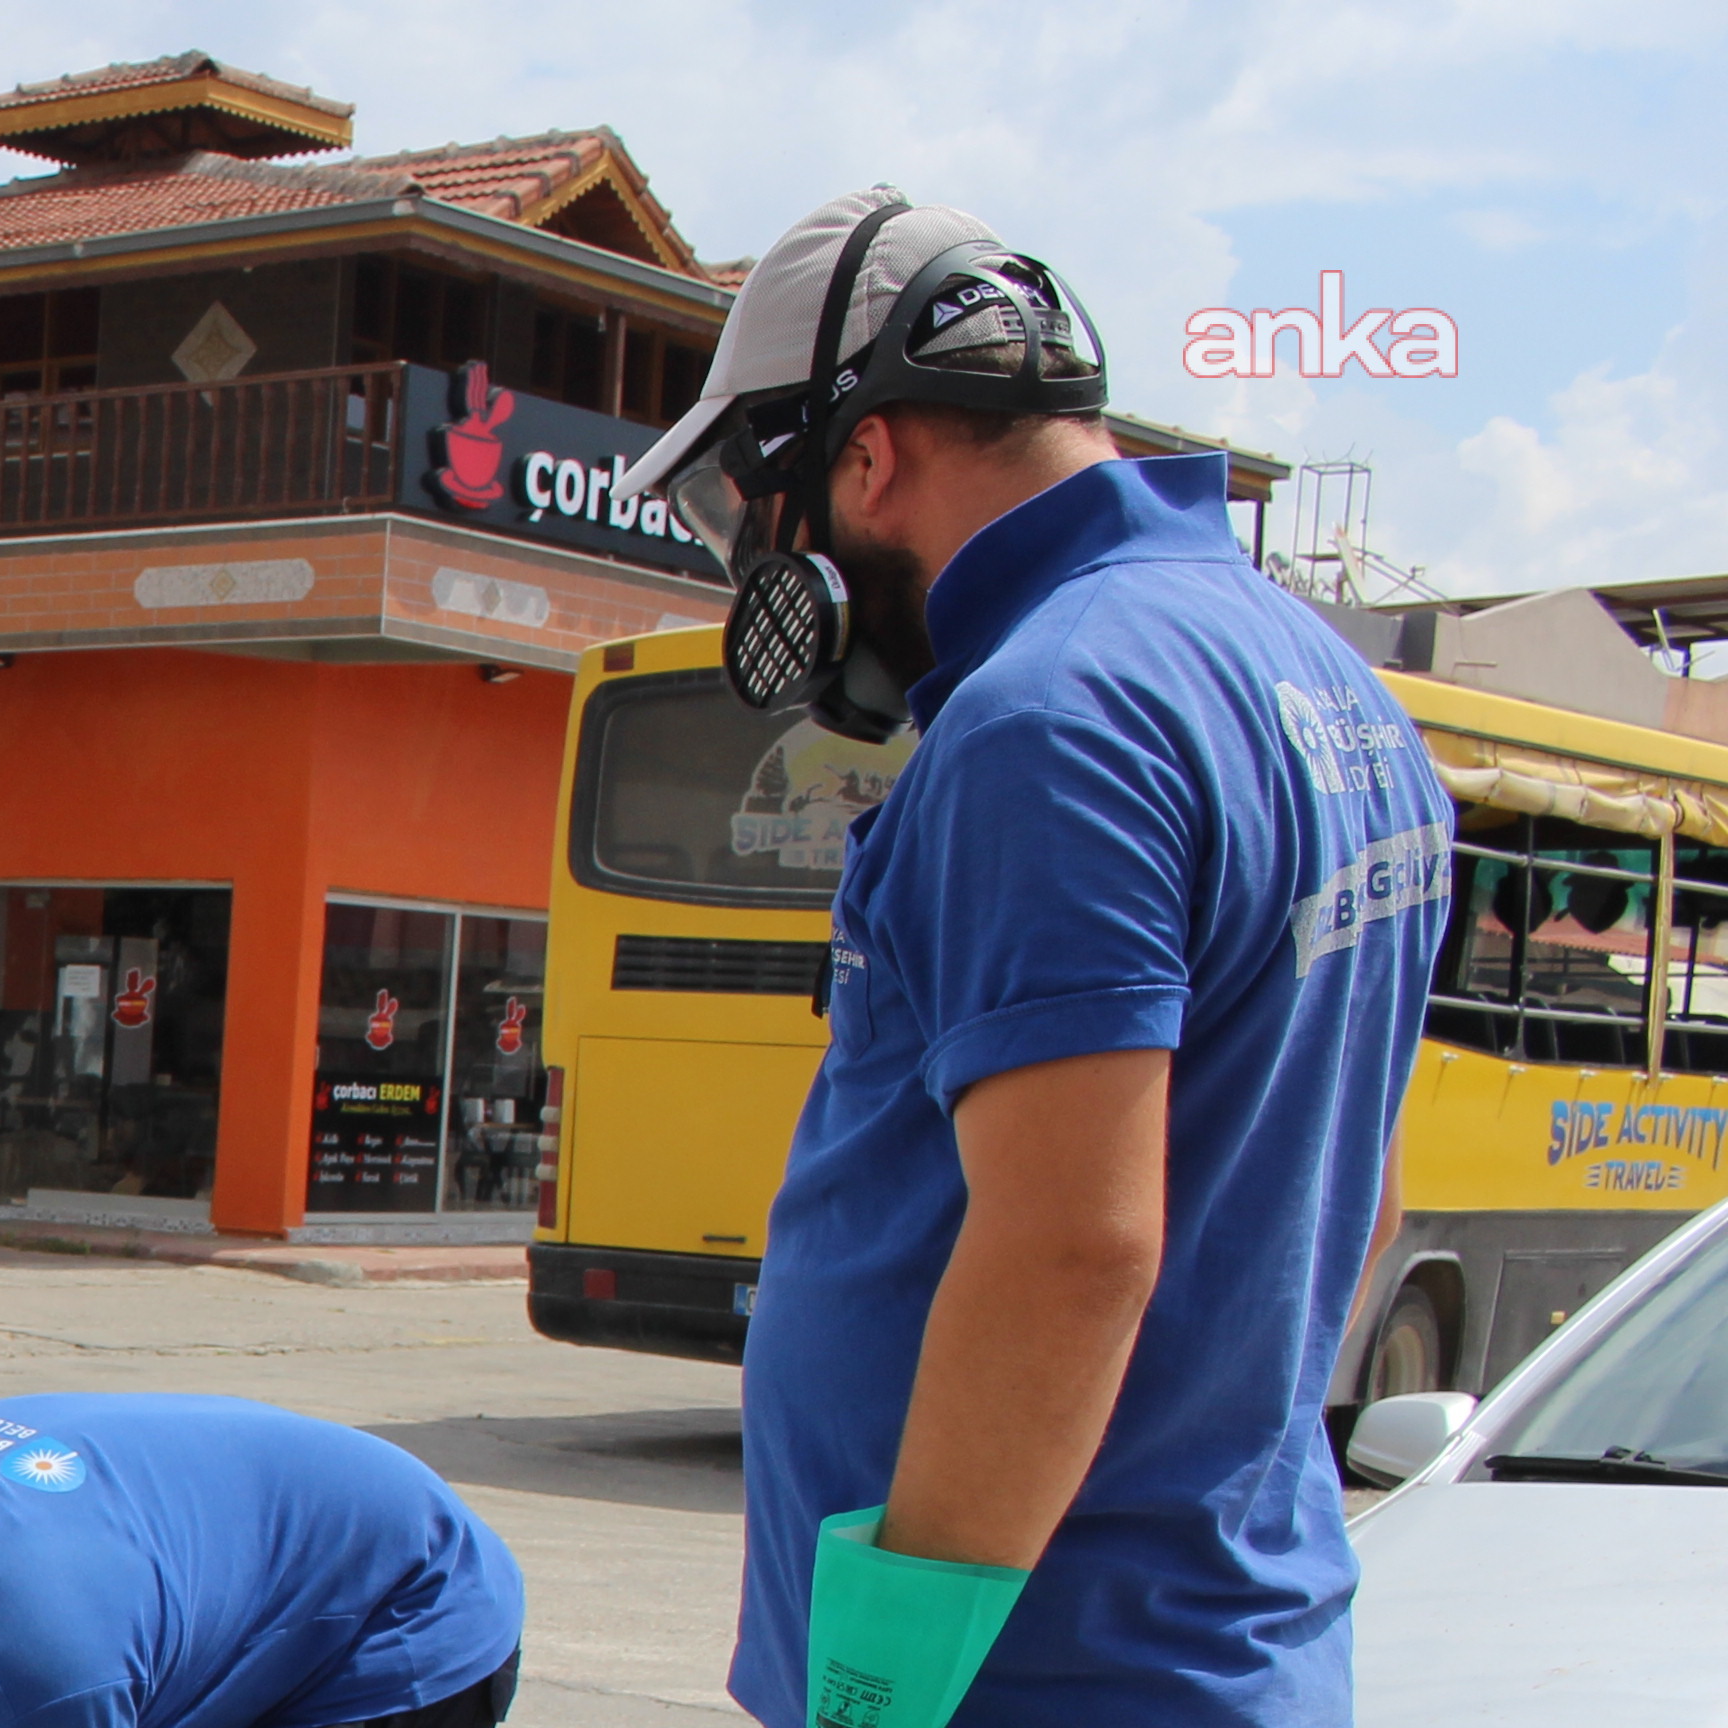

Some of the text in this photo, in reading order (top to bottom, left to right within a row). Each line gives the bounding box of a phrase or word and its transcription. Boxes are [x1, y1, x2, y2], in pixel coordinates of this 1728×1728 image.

[379, 1083, 421, 1102] ERDEM
[1616, 1104, 1728, 1171] ACTIVITY
[1604, 1160, 1667, 1191] TRAVEL
